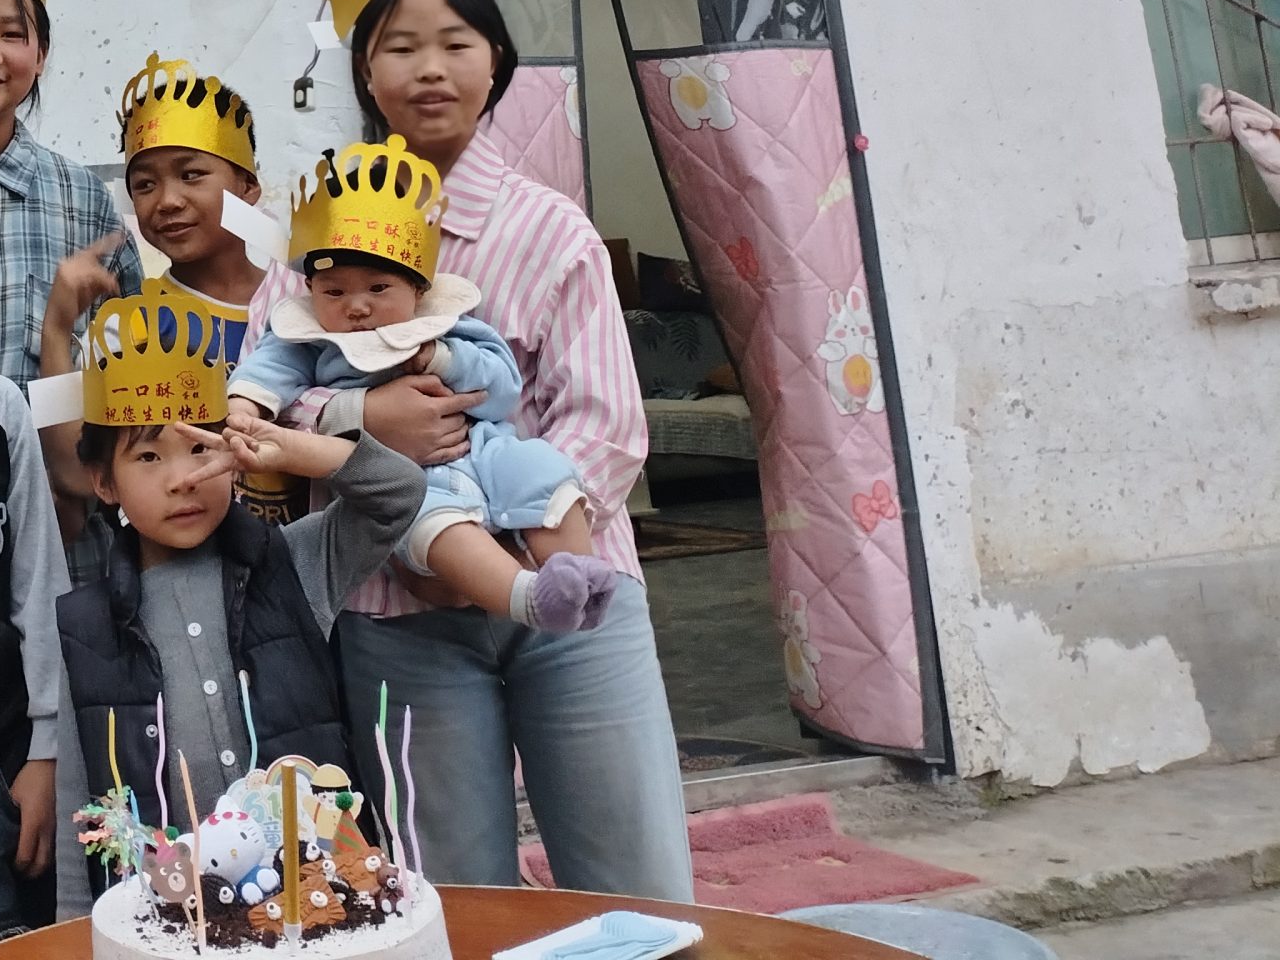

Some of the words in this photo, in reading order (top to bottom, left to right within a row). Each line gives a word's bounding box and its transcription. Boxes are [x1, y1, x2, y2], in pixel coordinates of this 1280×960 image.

[344, 217, 401, 239] 一口酥
[331, 234, 423, 269] 祝您生日快乐
[111, 382, 175, 399] 一口酥
[105, 404, 210, 423] 祝您生日快乐
